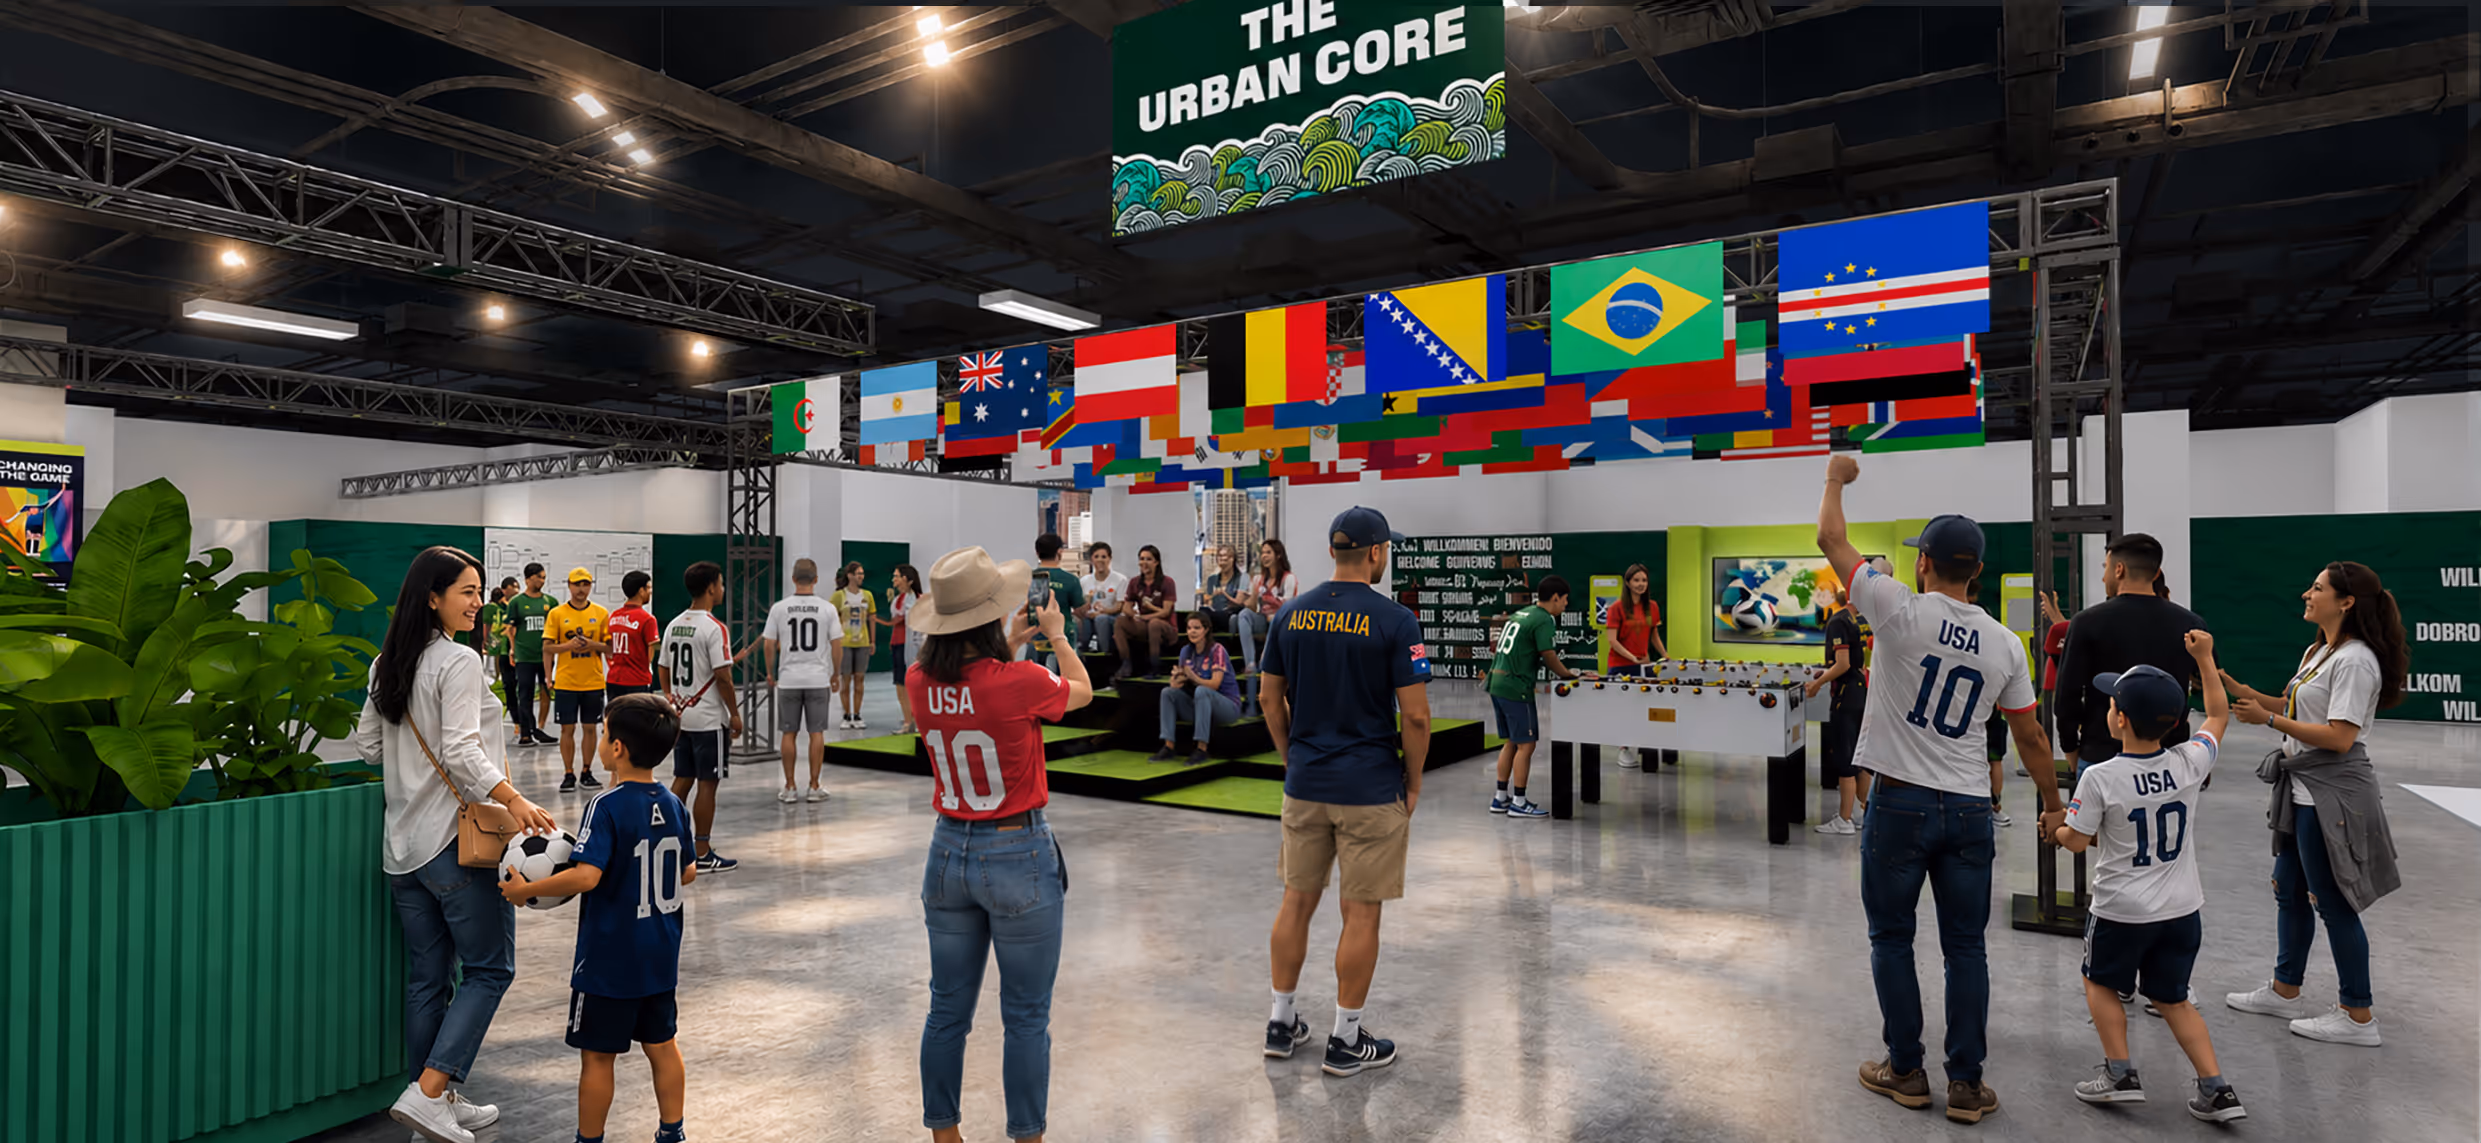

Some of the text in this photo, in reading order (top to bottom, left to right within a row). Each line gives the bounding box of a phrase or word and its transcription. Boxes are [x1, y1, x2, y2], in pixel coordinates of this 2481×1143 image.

[1241, 0, 1337, 51] THE
[1139, 5, 1466, 132] URBAN CORE
[787, 617, 818, 652] 10
[1288, 610, 1369, 637] AUSTRALIA
[1938, 619, 1979, 655] USA
[669, 641, 694, 687] 19
[928, 686, 975, 715] USA
[1906, 654, 1985, 739] 10
[926, 730, 1006, 811] 10
[2133, 769, 2177, 796] USA
[2127, 800, 2187, 868] 10
[634, 836, 682, 919] 10
